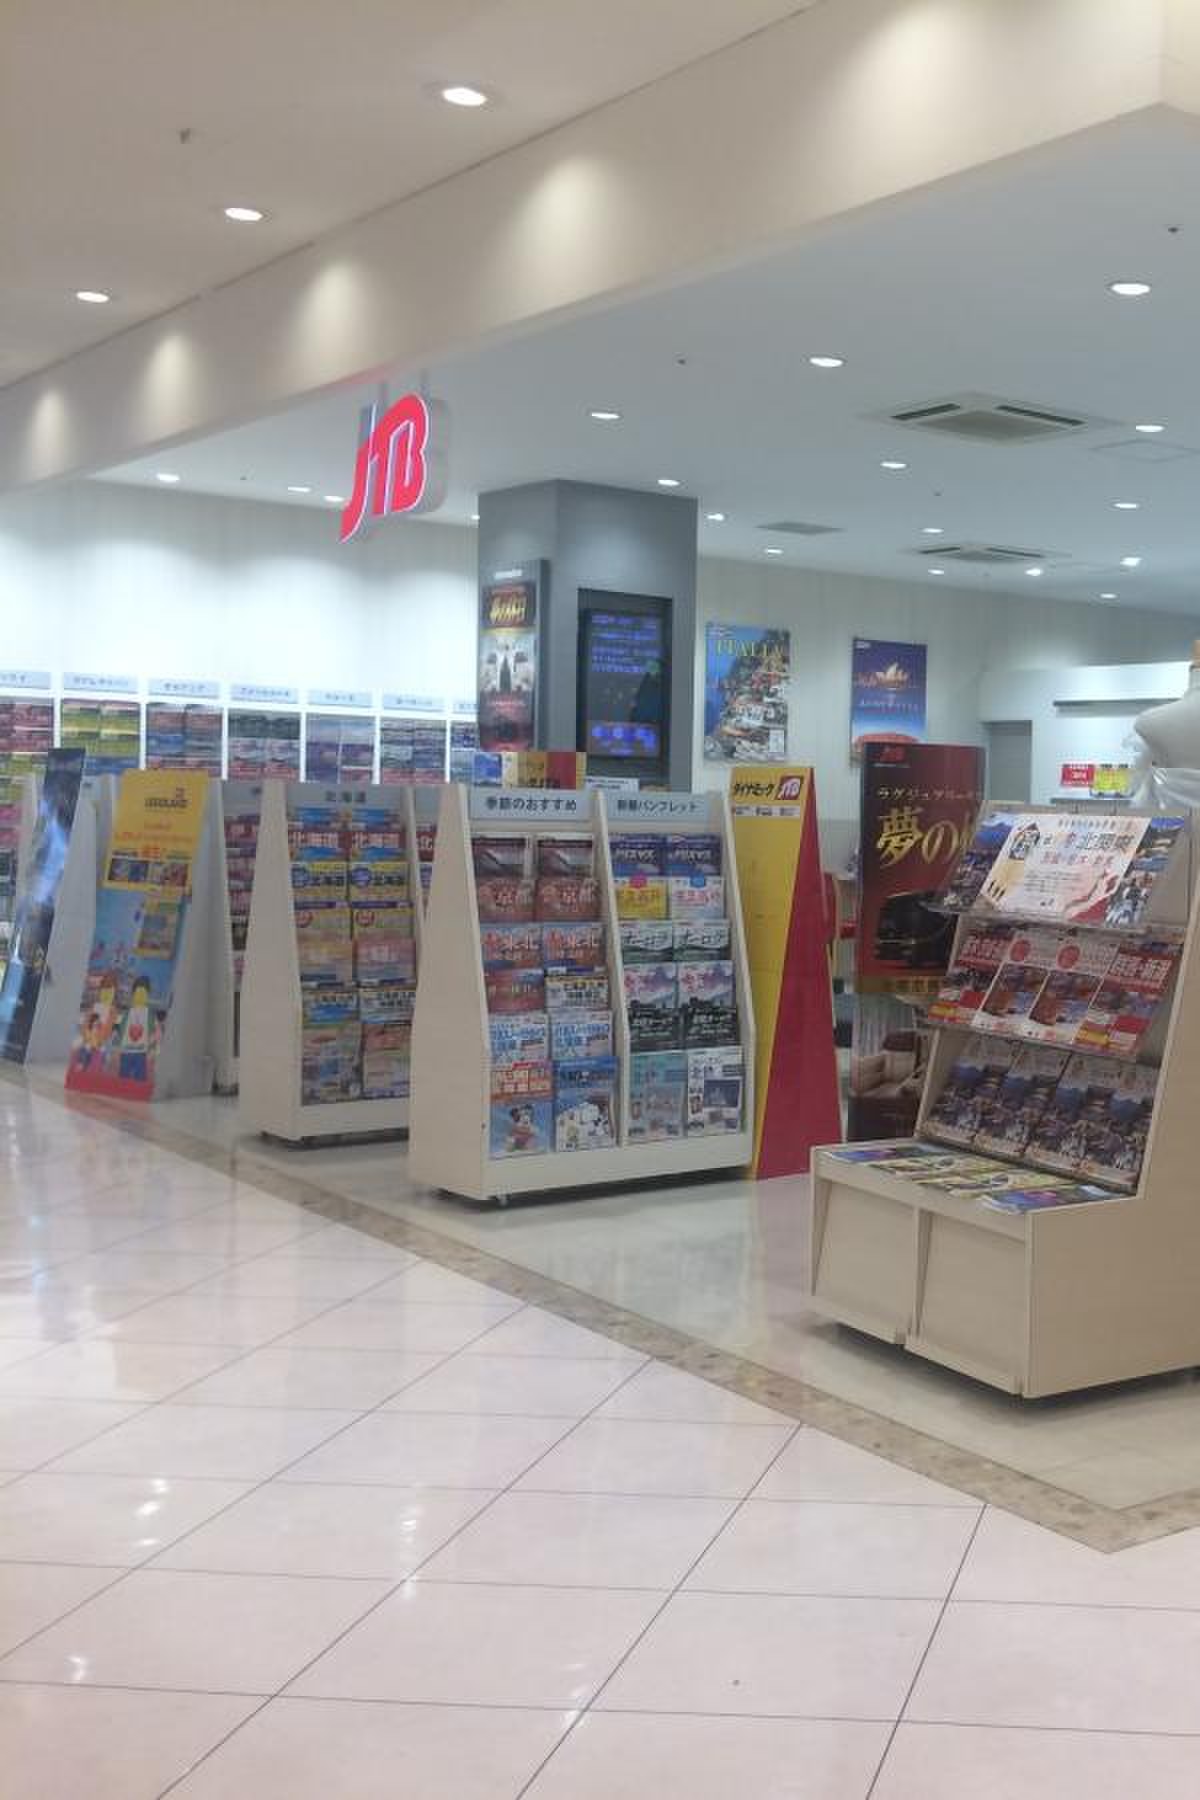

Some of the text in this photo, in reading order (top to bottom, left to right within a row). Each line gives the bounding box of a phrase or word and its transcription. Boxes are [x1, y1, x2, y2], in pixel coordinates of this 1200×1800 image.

[338, 391, 430, 545] JTB
[485, 796, 577, 812] 季節のおすすめ
